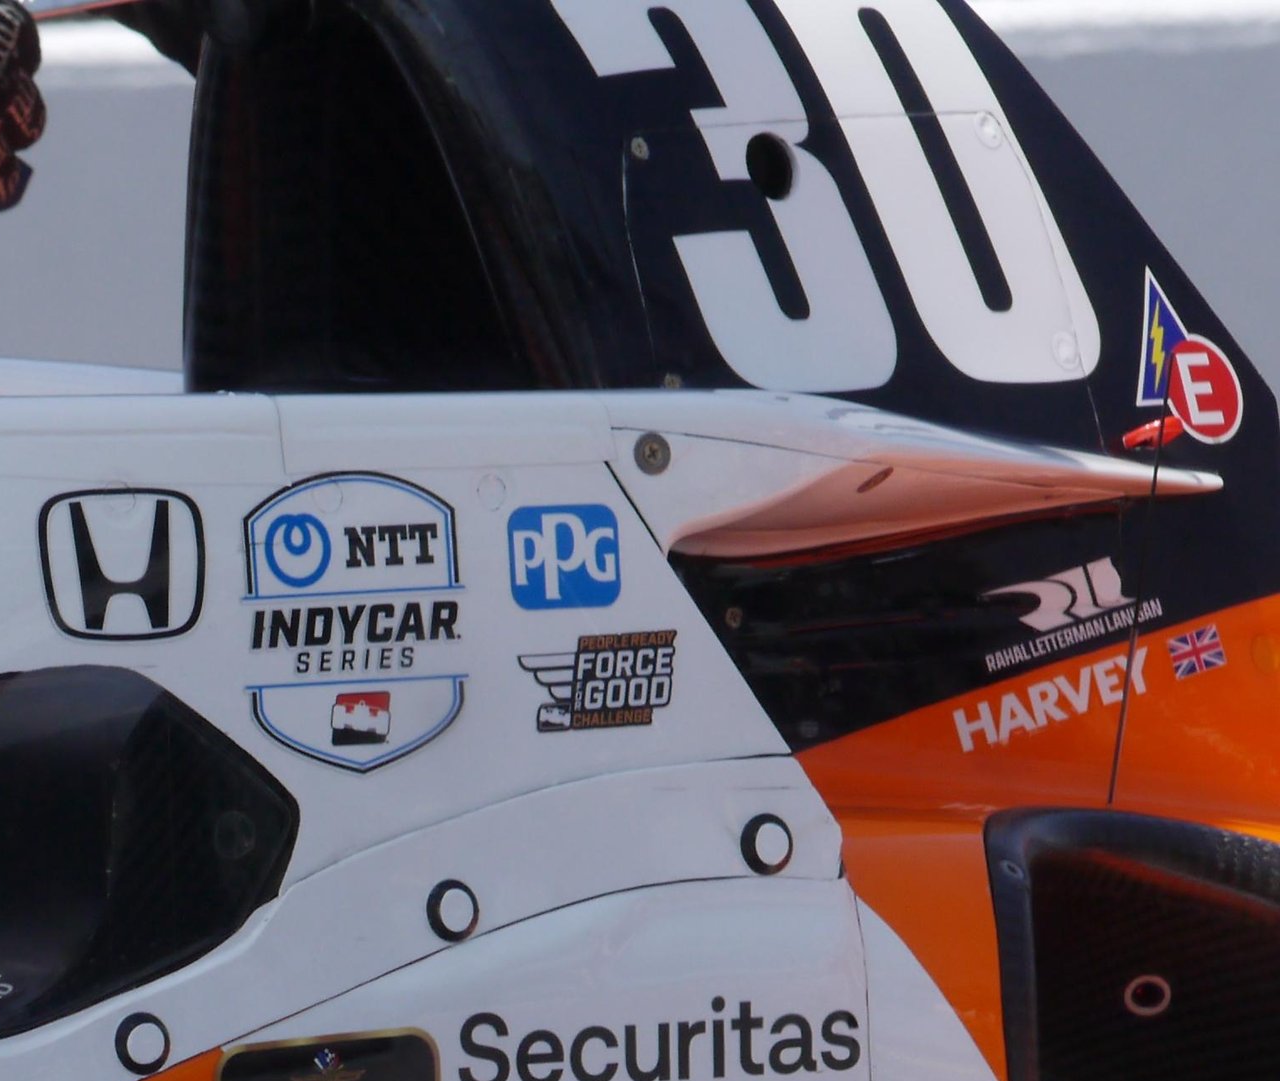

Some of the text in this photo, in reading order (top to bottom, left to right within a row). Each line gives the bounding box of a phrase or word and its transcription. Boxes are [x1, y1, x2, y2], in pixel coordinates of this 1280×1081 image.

[550, 0, 1101, 392] 30
[1174, 352, 1226, 426] E
[343, 521, 439, 569] NTT
[513, 512, 618, 600] PPG
[251, 600, 462, 650] INDYCAR
[985, 643, 1032, 672] RAHAL
[1030, 617, 1107, 658] LETTERMAN
[295, 646, 416, 674] SERIES
[577, 646, 674, 680] FORCE
[572, 709, 652, 727] CHALLENGE
[583, 676, 671, 710] GOOD
[952, 646, 1149, 753] HARVEY
